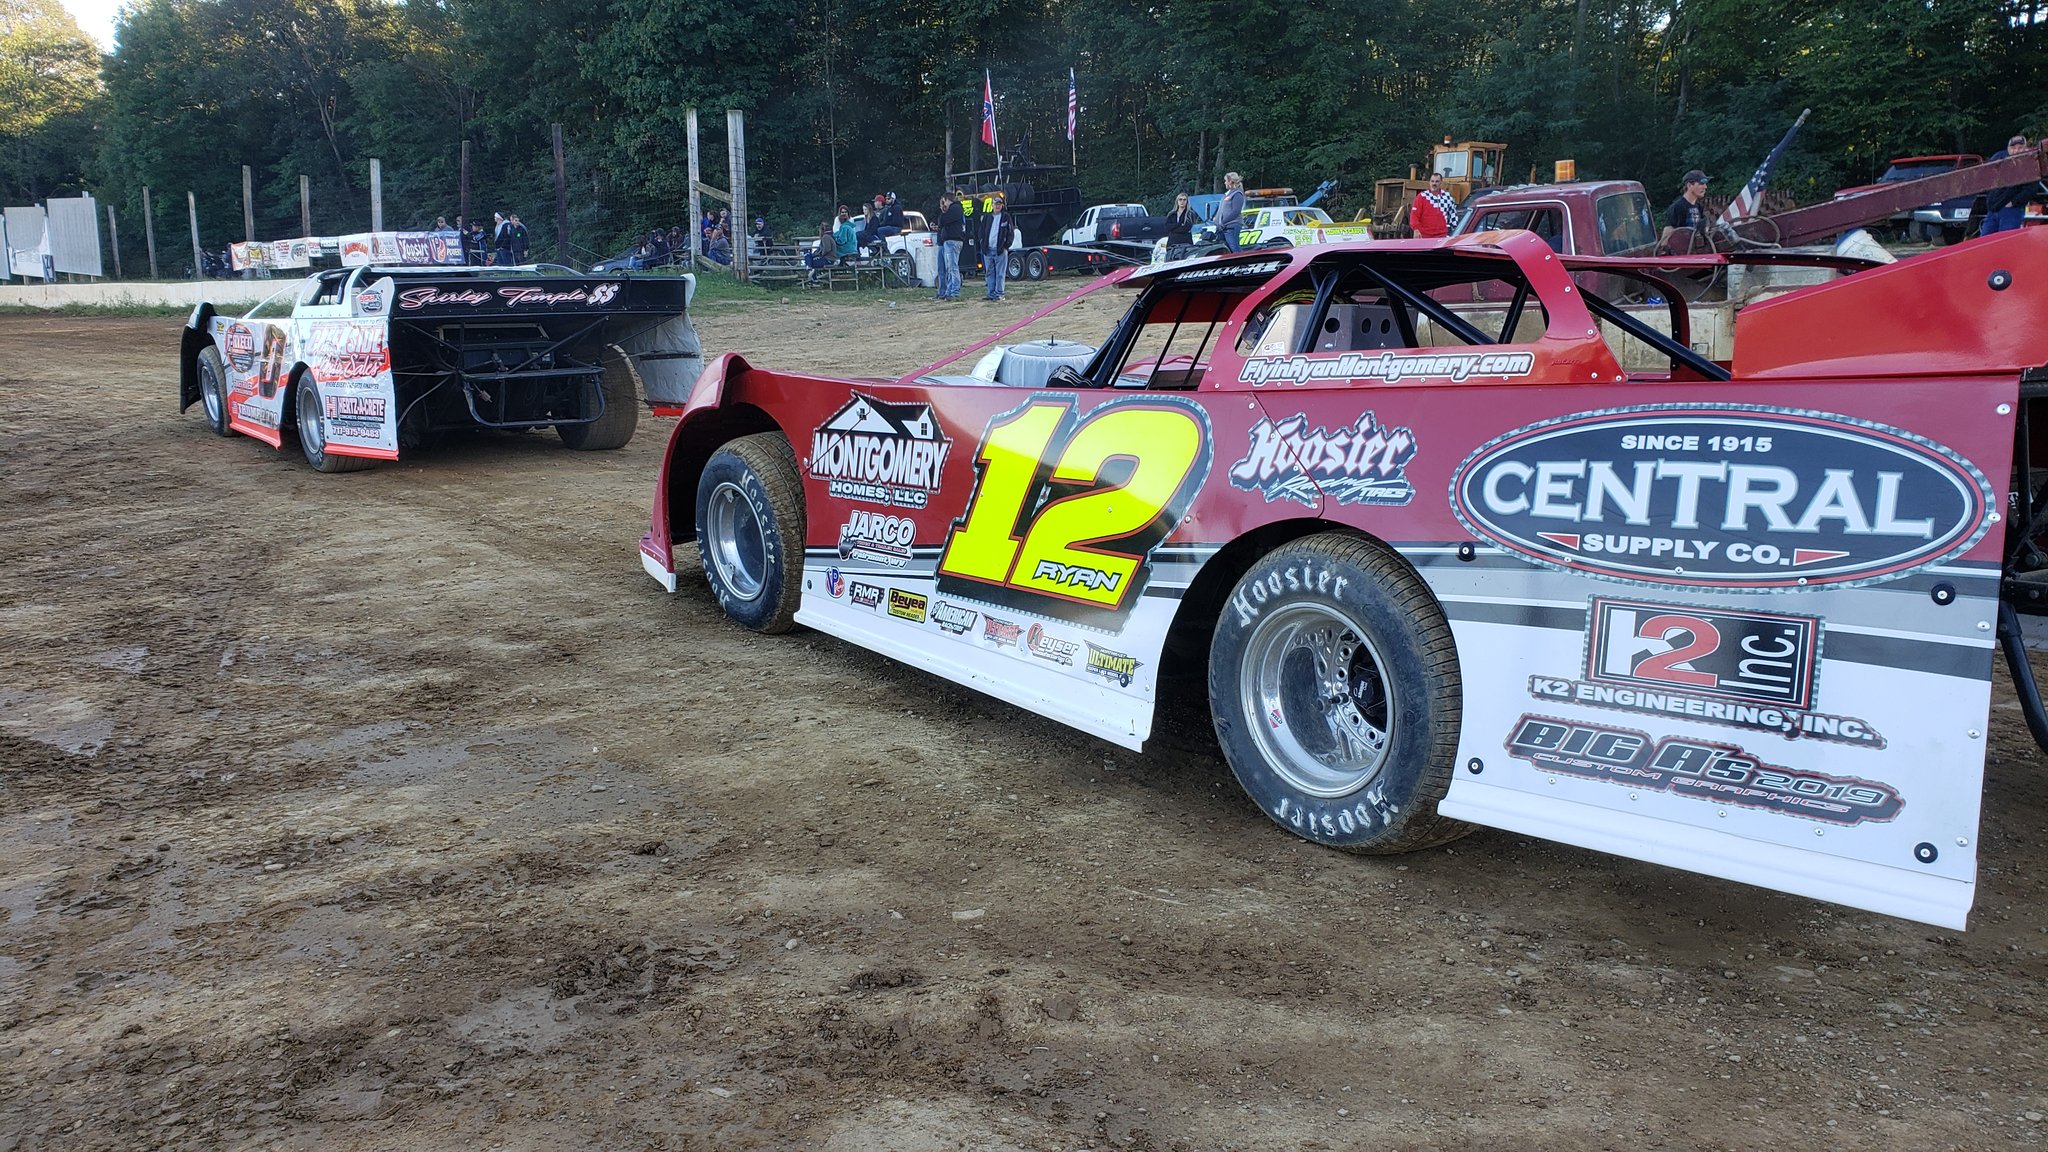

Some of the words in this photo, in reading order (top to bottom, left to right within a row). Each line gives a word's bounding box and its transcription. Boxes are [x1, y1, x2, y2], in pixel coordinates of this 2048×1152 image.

[400, 287, 491, 308] Shirley
[344, 353, 380, 378] Sales
[1242, 352, 1531, 383] FlyinRyanMontgomery.com
[338, 397, 385, 417] HERTZ-A-CRETE
[1233, 413, 1411, 479] Hoosier
[1621, 434, 1700, 452] SINCE
[1707, 435, 1773, 454] 1915
[811, 432, 949, 489] MONTGOMERY
[831, 481, 891, 502] HOMES,
[895, 488, 926, 505] LLC
[941, 404, 1201, 605] 12
[1358, 486, 1409, 499] TIRES
[1482, 457, 1935, 540] CENTRAL
[848, 511, 915, 545] JARCO
[891, 558, 907, 568] WV
[1582, 532, 1721, 562] SUPPLY
[1726, 541, 1791, 567] CO.
[854, 584, 880, 600] RMR
[1032, 560, 1122, 592] RYAN
[891, 591, 926, 610] Beyea
[1233, 558, 1350, 628] Hoosier
[1028, 625, 1080, 656] Keyser
[1607, 608, 1721, 688] K2
[1088, 647, 1136, 675] ULTIMATE
[1533, 678, 1571, 697] K2
[1575, 685, 1792, 733] ENGINEERING,
[1801, 714, 1874, 741] INC.
[1511, 720, 1643, 763] BIG
[1754, 771, 1886, 806] 2019
[1533, 752, 1662, 781] CUSTOM
[1671, 776, 1852, 814] GRAPHICS
[1273, 779, 1399, 842] Hoosier
